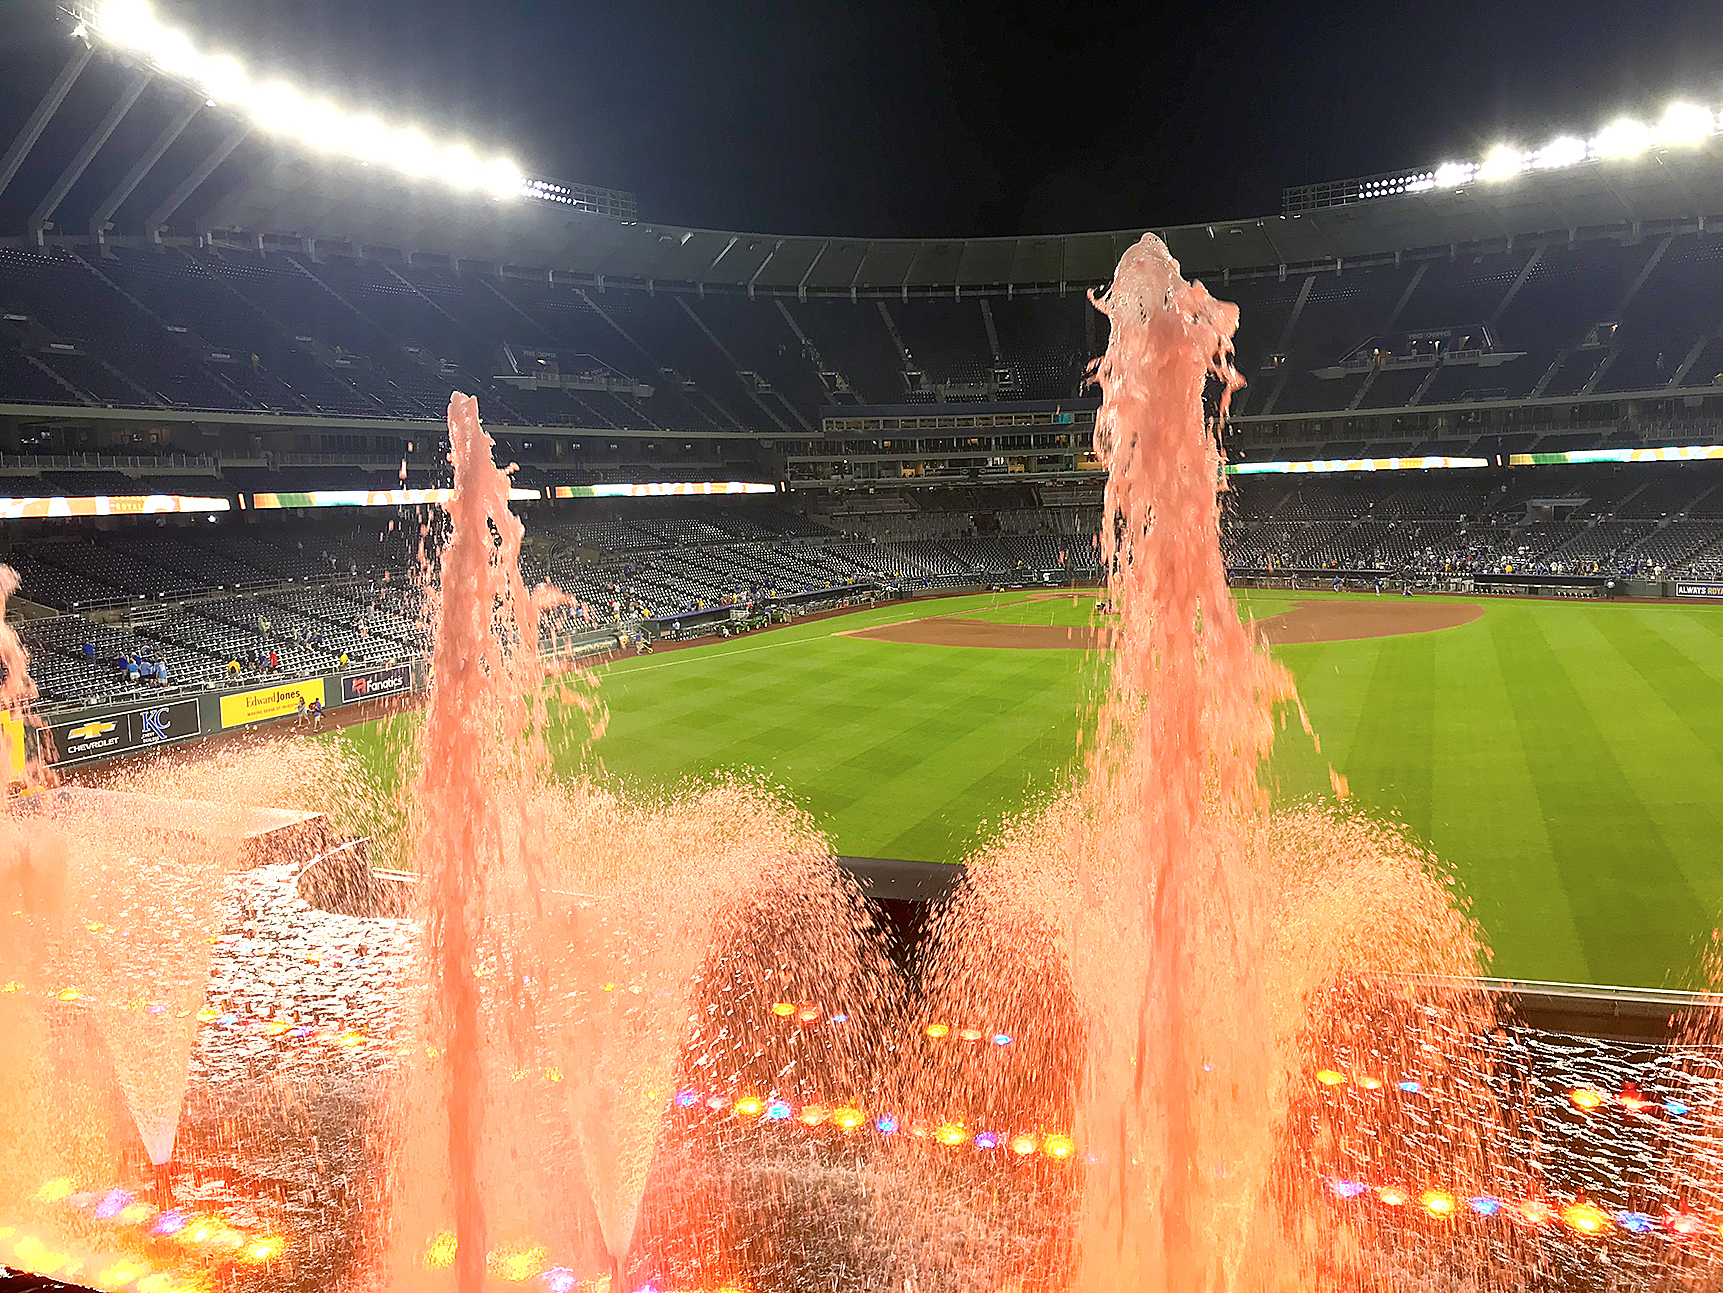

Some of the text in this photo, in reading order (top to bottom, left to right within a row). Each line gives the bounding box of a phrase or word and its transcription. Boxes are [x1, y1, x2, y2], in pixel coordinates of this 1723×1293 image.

[1678, 586, 1706, 595] ALWAYS
[366, 675, 403, 693] Fanatics
[67, 737, 120, 754] CHEVROLET
